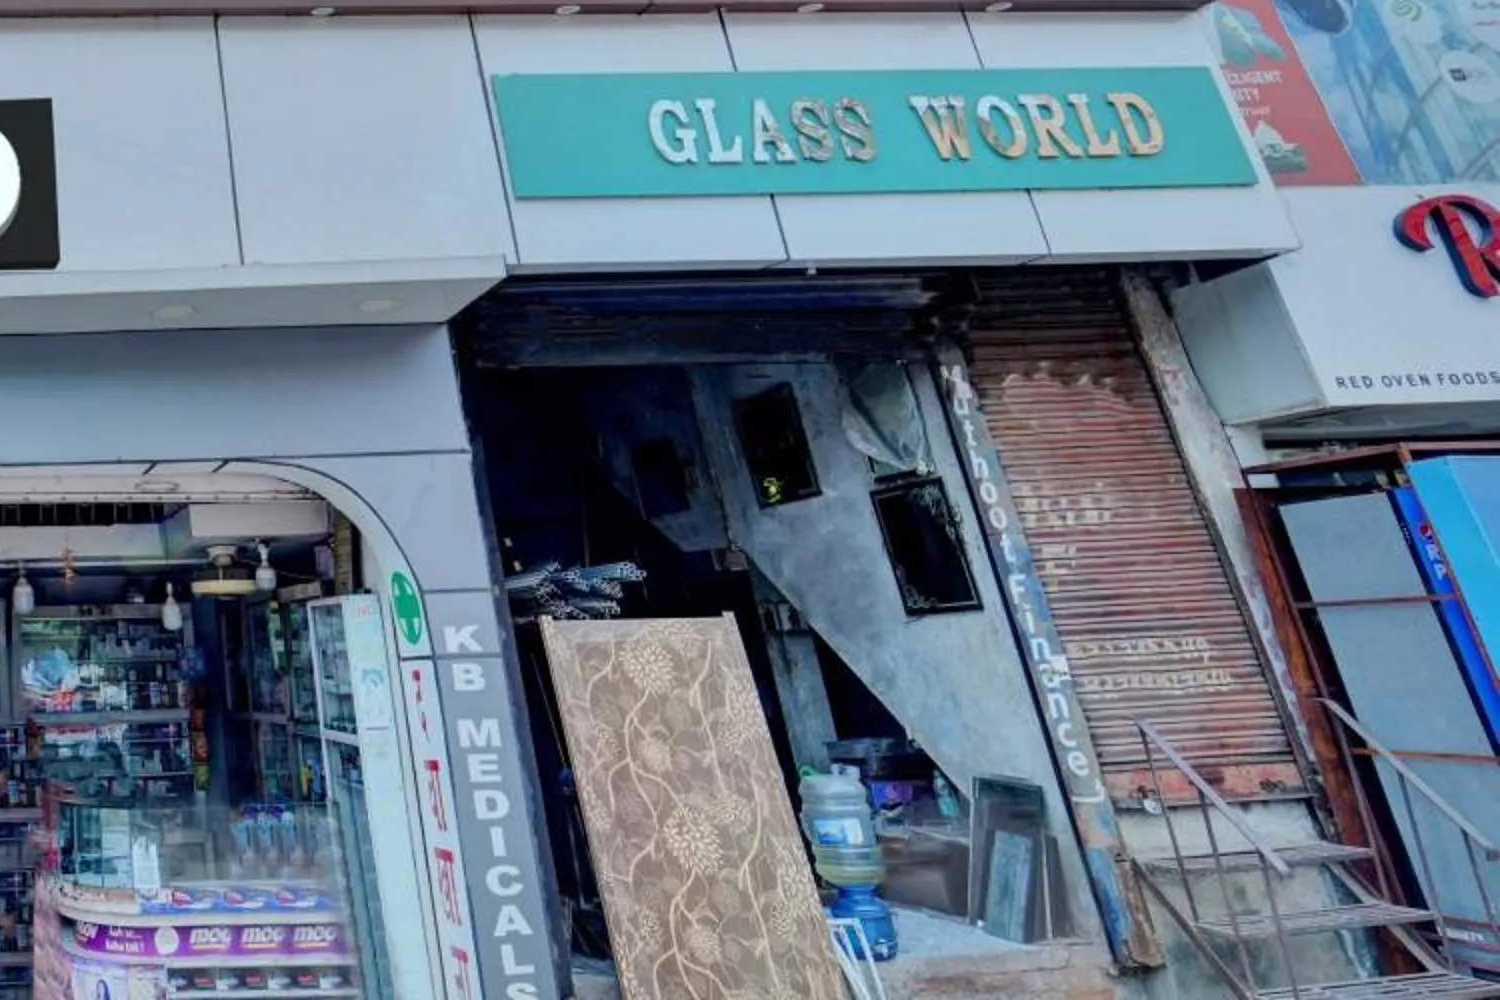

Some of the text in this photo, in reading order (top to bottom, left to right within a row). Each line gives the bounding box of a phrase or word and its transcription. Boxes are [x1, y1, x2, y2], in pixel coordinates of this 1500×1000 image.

[646, 91, 1166, 165] GLASS WORLD
[1335, 371, 1500, 390] RED OVEN FOODS
[442, 624, 486, 691] KB
[456, 718, 539, 1000] MEDICALS
